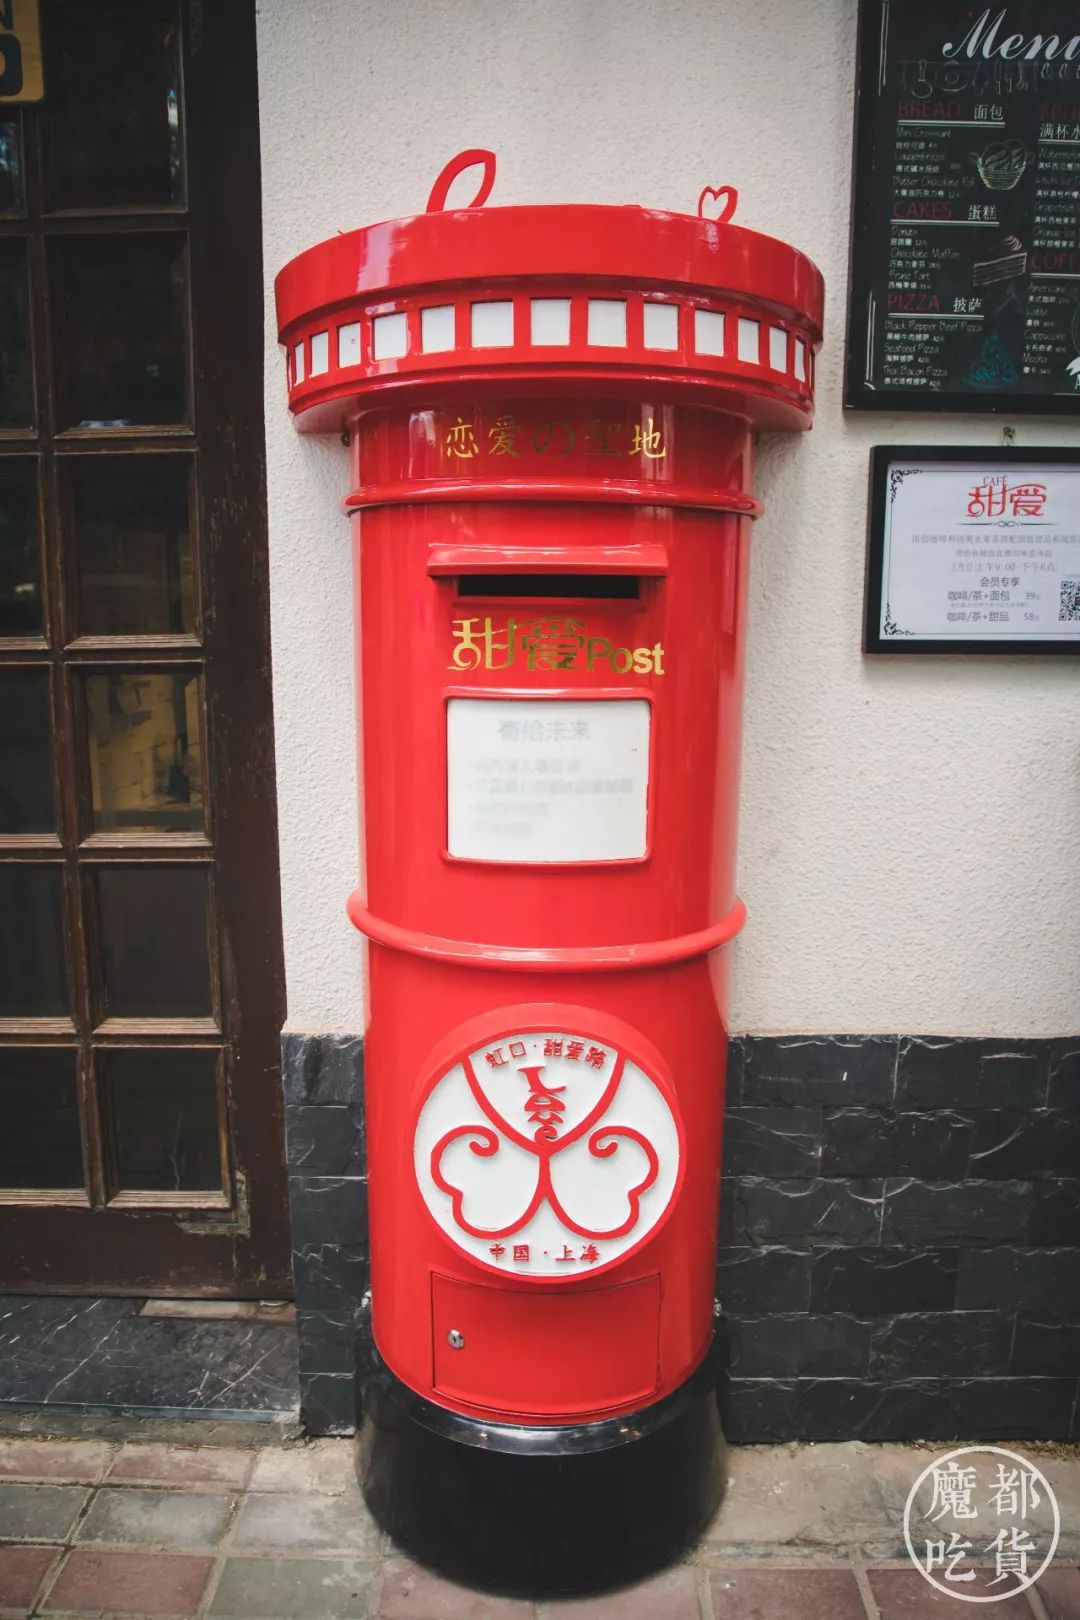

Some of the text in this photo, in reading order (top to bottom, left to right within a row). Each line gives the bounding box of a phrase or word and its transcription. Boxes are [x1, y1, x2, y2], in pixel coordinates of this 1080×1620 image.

[898, 100, 960, 118] BREAD
[973, 104, 1003, 121] 面包
[893, 201, 953, 219] CAKES
[967, 204, 997, 221] 蛋糕
[887, 293, 940, 311] PIZZA
[953, 297, 983, 313] 披萨
[979, 576, 1020, 588] 会员专享
